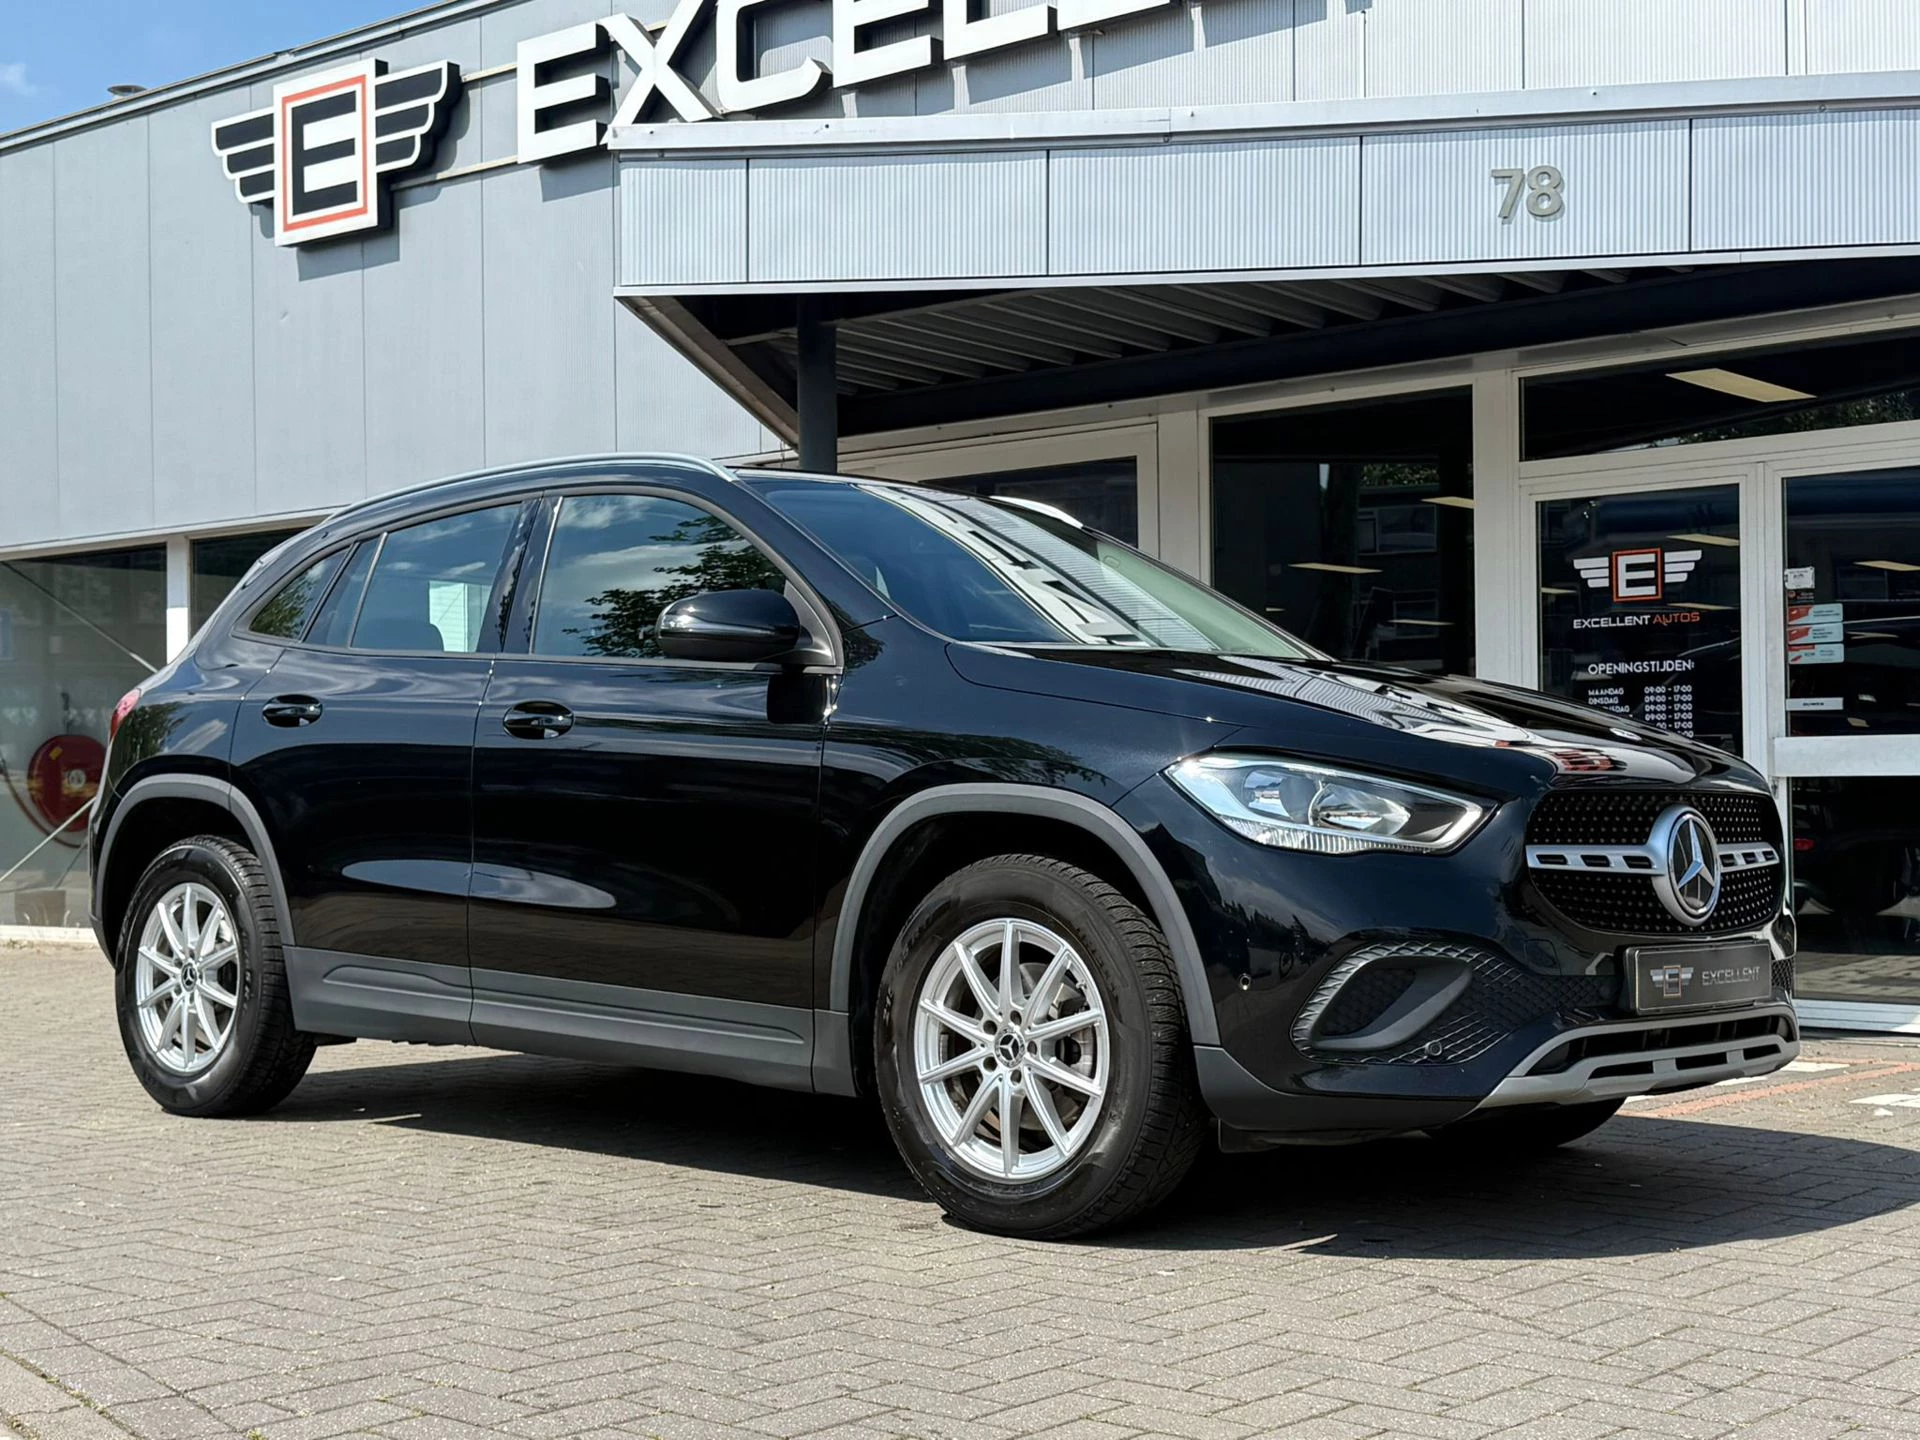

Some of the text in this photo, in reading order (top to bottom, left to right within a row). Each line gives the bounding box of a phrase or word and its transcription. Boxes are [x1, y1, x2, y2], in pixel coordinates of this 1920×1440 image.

[517, 0, 1171, 164] EXCEL
[291, 90, 359, 217] E
[1491, 165, 1564, 219] 78
[1617, 553, 1657, 598] E
[1573, 612, 1700, 629] EXCELLENT AUTOS
[1588, 659, 1695, 675] OPENINGSTIJDEN:
[1588, 687, 1624, 696] MAANDAG
[1588, 696, 1619, 705] DINSDAG
[1702, 965, 1761, 986] EXCELLENT
